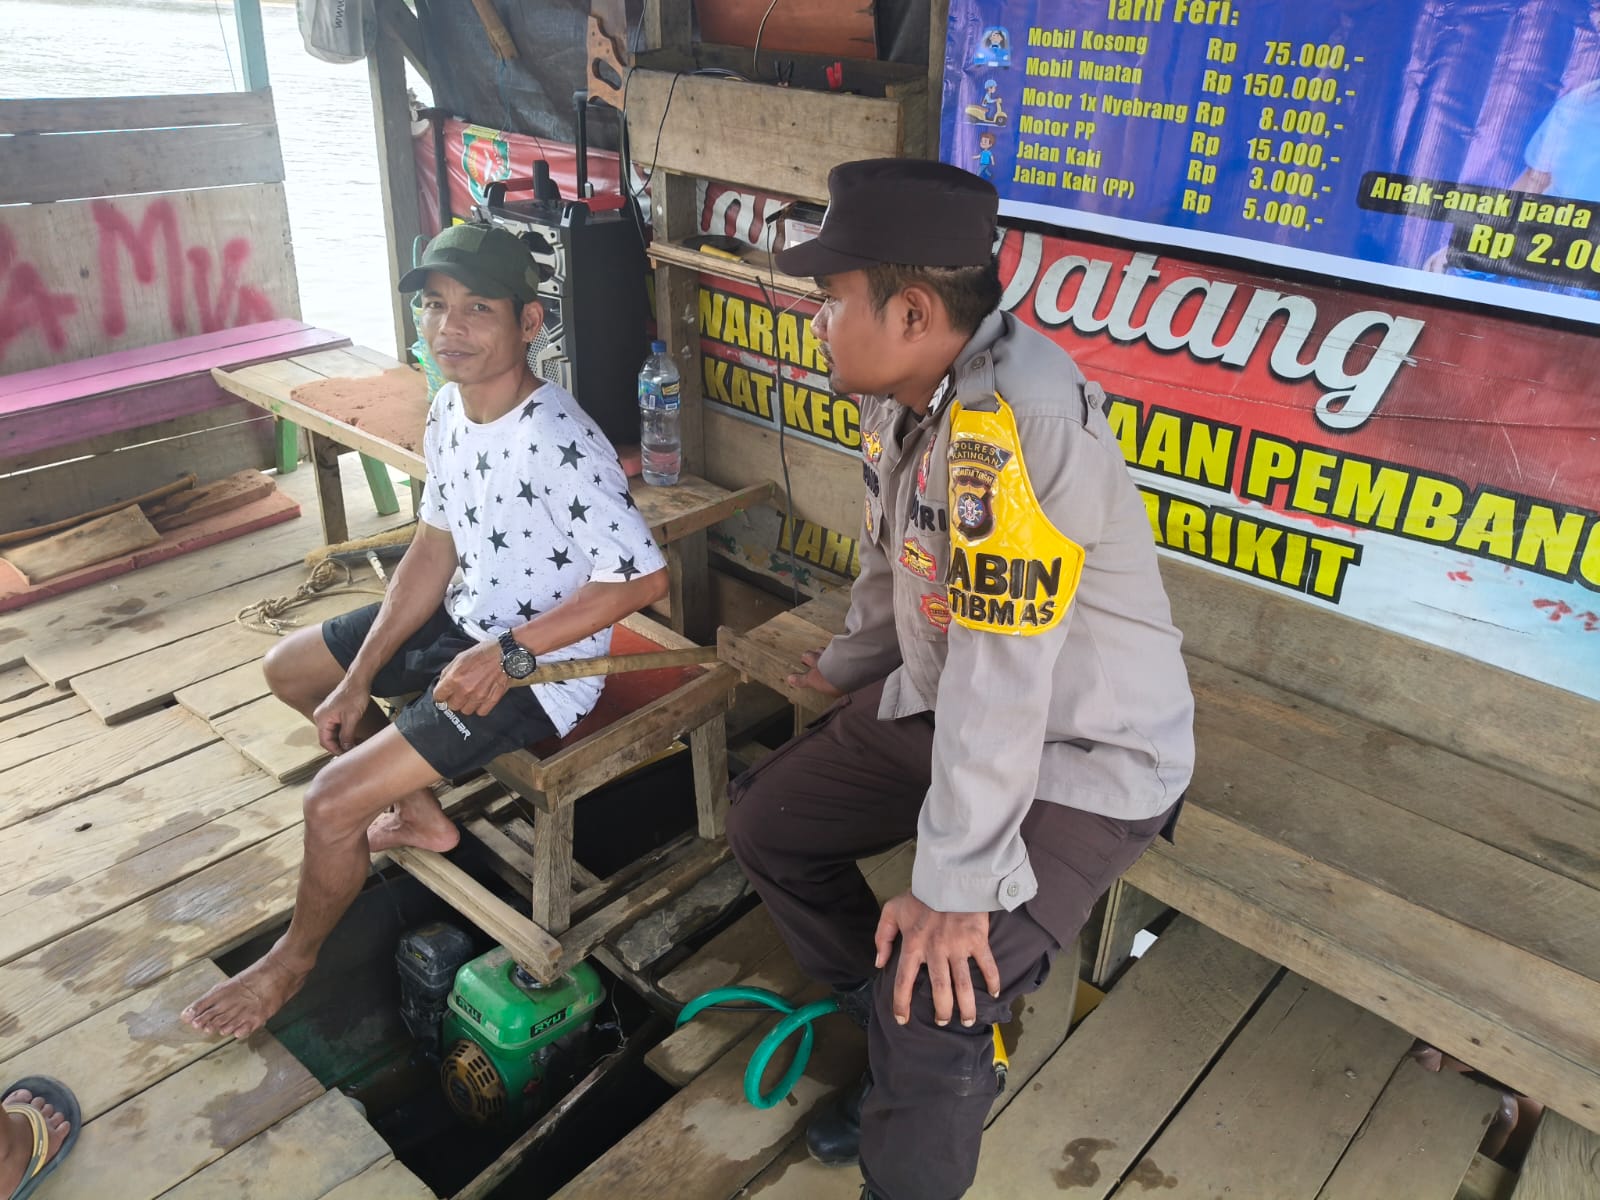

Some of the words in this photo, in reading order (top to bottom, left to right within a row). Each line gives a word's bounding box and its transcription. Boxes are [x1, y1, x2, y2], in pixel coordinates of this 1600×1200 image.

[1028, 27, 1076, 49] Mobil
[1081, 30, 1149, 55] Kosong
[1206, 37, 1238, 64] Rp
[1264, 41, 1365, 71] 75.000,-
[1025, 57, 1073, 79] Mobil
[1078, 61, 1143, 84] Muatan
[1202, 69, 1232, 95] Rp
[1242, 73, 1356, 105] 150.000,-
[1022, 87, 1073, 110] Motor
[1080, 93, 1097, 112] 1x
[1101, 94, 1189, 123] Nyebrang
[1195, 101, 1226, 127] Rp
[1258, 107, 1344, 138] 8.000,-
[1019, 115, 1070, 137] Motor
[1073, 120, 1096, 141] PP
[1190, 131, 1220, 156] Rp
[1247, 138, 1341, 171] 15.000,-
[1016, 141, 1060, 163] Jalan
[1065, 147, 1102, 168] Kaki
[1187, 159, 1217, 185] Rp
[1248, 167, 1332, 199] 3.000,-
[1013, 165, 1057, 187] Jalan
[1061, 171, 1097, 193] Kaki
[1102, 177, 1135, 199] (PP)
[1181, 189, 1212, 215] Rp
[1242, 198, 1324, 232] 5.000,-
[1370, 176, 1512, 218] Anak-anak
[1517, 200, 1592, 229] pada
[1467, 223, 1517, 259] Rp
[953, 442, 996, 456] POLRES
[534, 1010, 563, 1035] RYU
